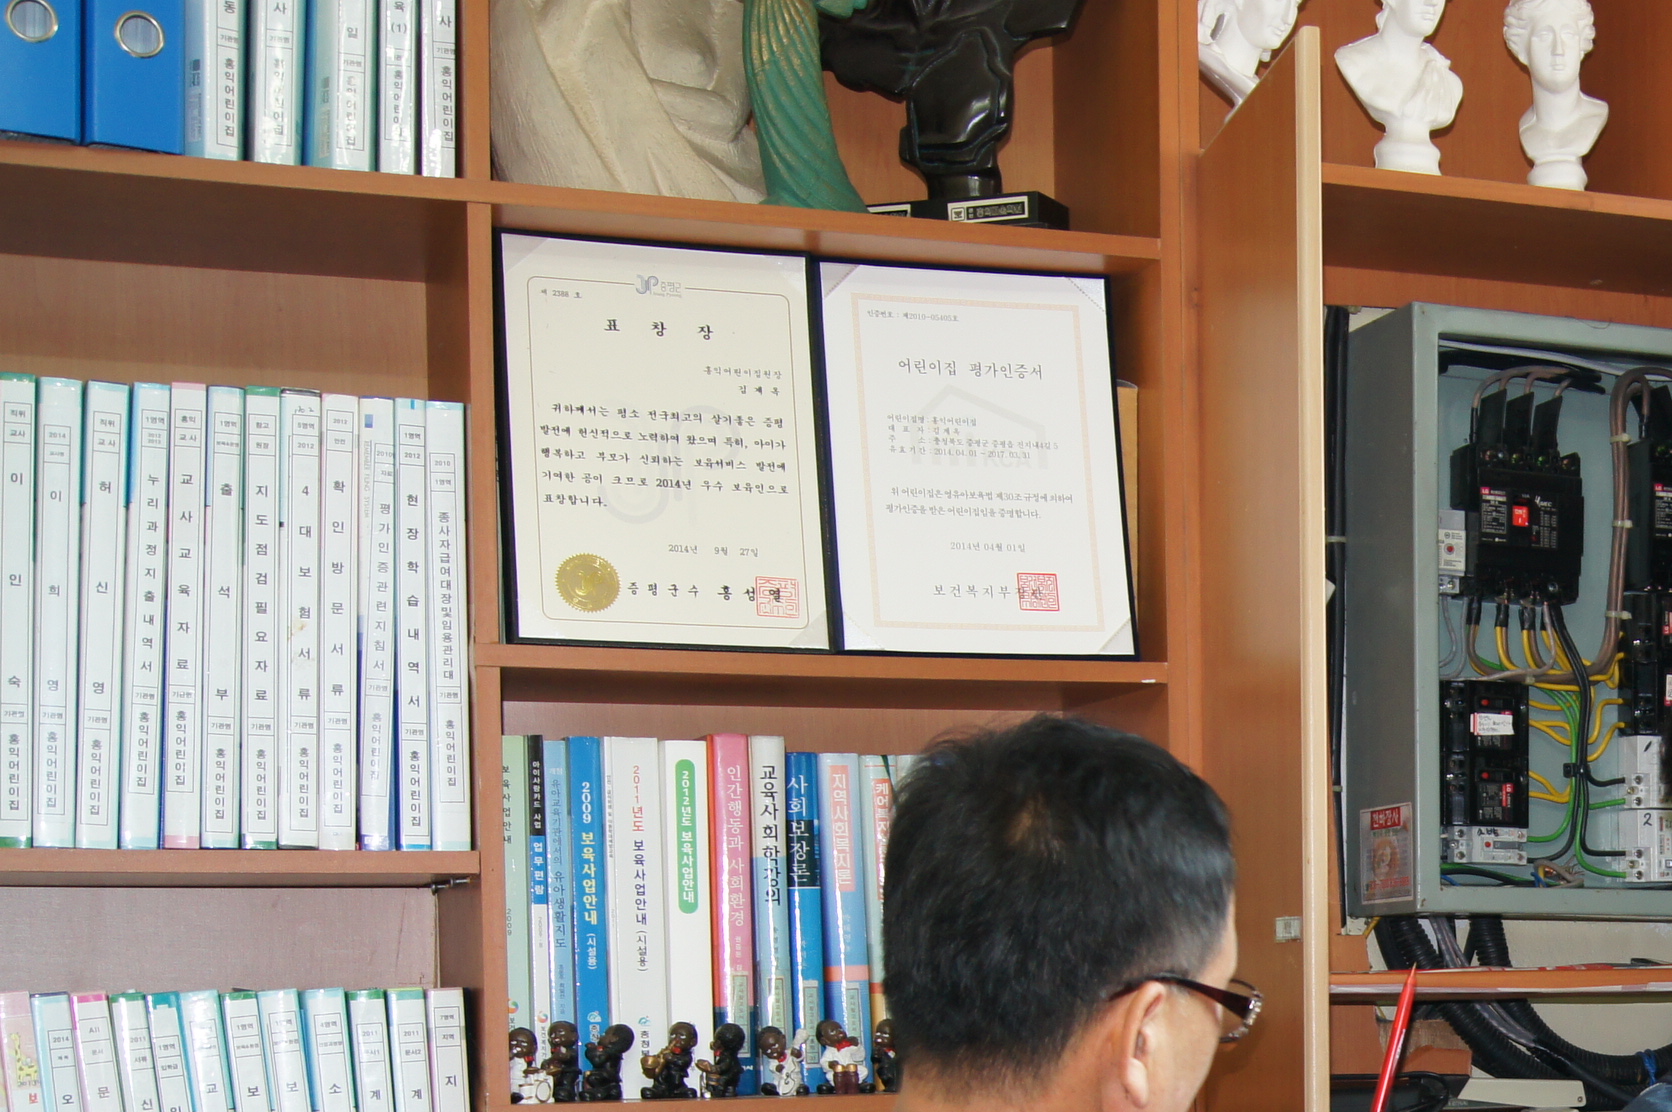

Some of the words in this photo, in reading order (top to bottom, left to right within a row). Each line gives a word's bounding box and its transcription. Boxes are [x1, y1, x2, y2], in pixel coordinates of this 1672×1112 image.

[899, 357, 957, 377] 어린이집
[969, 362, 1043, 380] 평가인증서
[540, 424, 571, 437] 발전에
[578, 427, 633, 441] 헌신적으로
[639, 431, 680, 443] 노력하여
[686, 434, 717, 447] 왔으며
[753, 439, 786, 451] 아이가
[617, 407, 639, 419] 평소
[712, 413, 756, 427] 살기좋은
[763, 416, 783, 429] 증평
[404, 452, 421, 460] 2012
[541, 446, 586, 460] 행복하고
[596, 451, 630, 464] 부모가
[639, 454, 683, 467] 신뢰하는
[694, 458, 746, 470] 보육서비스
[755, 460, 786, 473] 발전에
[542, 470, 575, 483] 기여한
[583, 472, 603, 485] 공이
[611, 474, 648, 487] 크므로
[655, 478, 692, 490] 2014년
[701, 480, 724, 492] 우수
[731, 482, 789, 495] 보육인으로
[543, 493, 608, 508] 표창합니다.
[668, 543, 698, 555] 2014년
[627, 582, 699, 598] 증평군수
[581, 782, 592, 824] 2009
[681, 770, 693, 826] 2012년도
[726, 765, 744, 851] 인간행동과
[759, 765, 782, 907] 교육사회학강의
[786, 774, 811, 883] 사회보장론
[831, 773, 852, 885] 지역사회복지론
[533, 841, 545, 895] 업무편람
[581, 832, 598, 925] 보육사업안내
[633, 840, 648, 926] 보육사업안내
[681, 831, 695, 904] 보육사업안내
[728, 857, 745, 927] 사회환경
